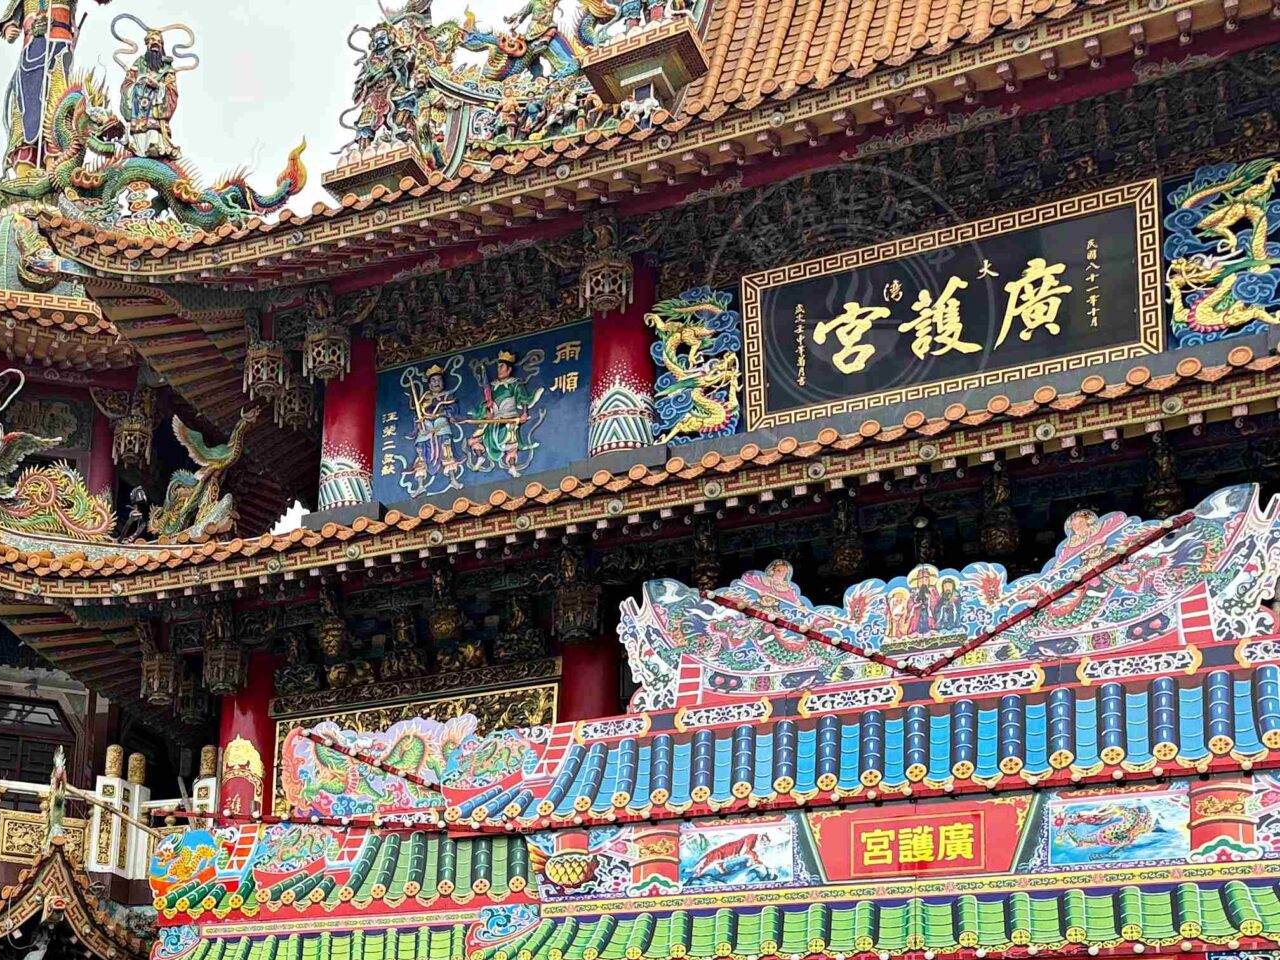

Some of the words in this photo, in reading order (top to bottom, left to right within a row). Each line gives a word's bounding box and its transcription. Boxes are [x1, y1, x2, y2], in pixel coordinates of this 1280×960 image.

[811, 256, 1073, 376] 廣護宮
[549, 340, 581, 394] 雨順
[860, 821, 976, 868] 廣護宮
